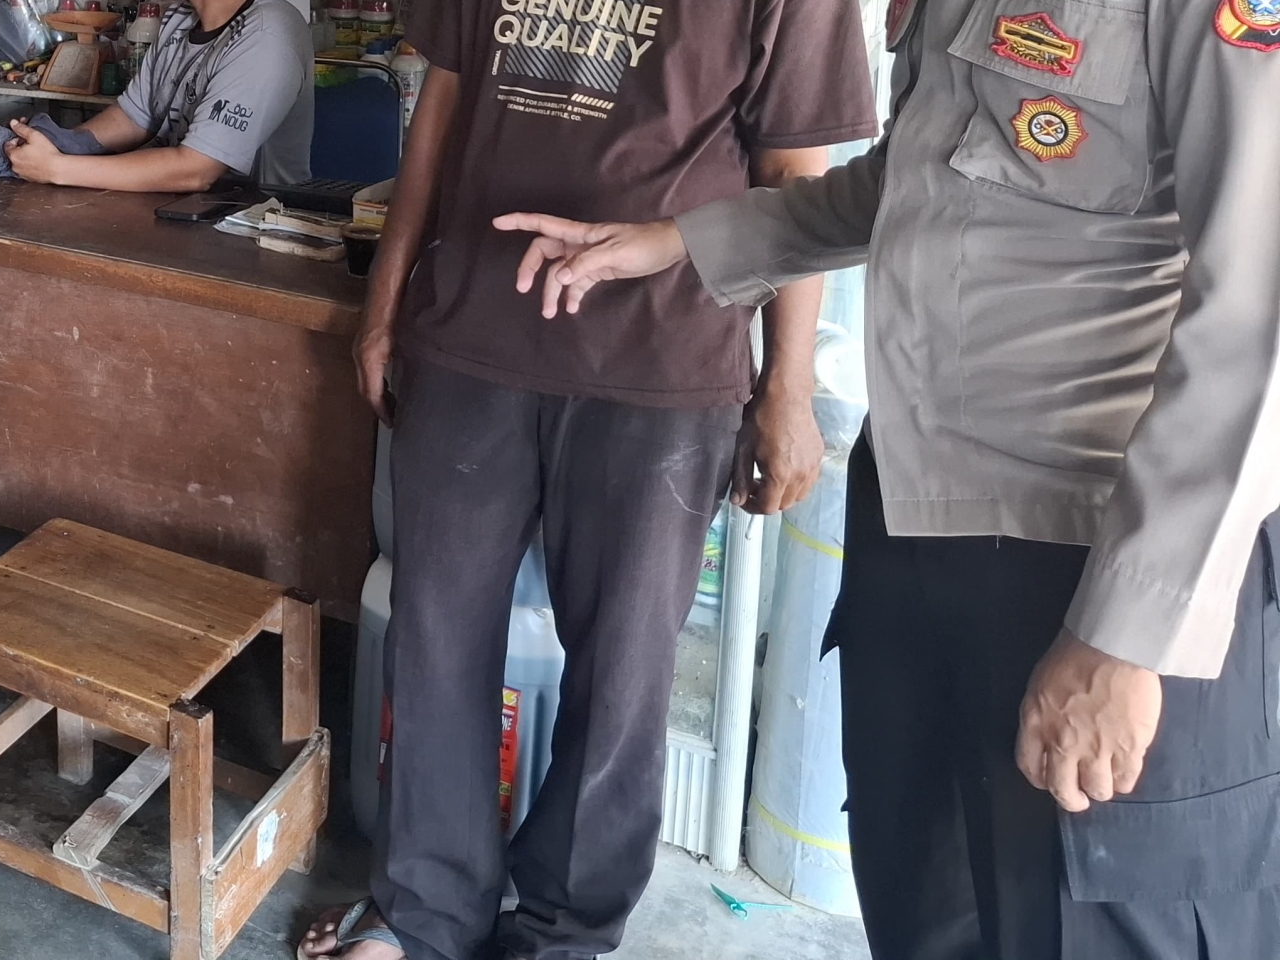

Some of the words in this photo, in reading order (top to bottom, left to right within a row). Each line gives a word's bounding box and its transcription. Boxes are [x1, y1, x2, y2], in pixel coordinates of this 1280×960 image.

[493, 13, 654, 68] QUALITY
[491, 49, 502, 76] ORIGINAL
[506, 103, 525, 112] DENIM
[525, 98, 538, 106] FOR
[572, 105, 608, 120] STRENGTH
[221, 113, 249, 133] NOUG
